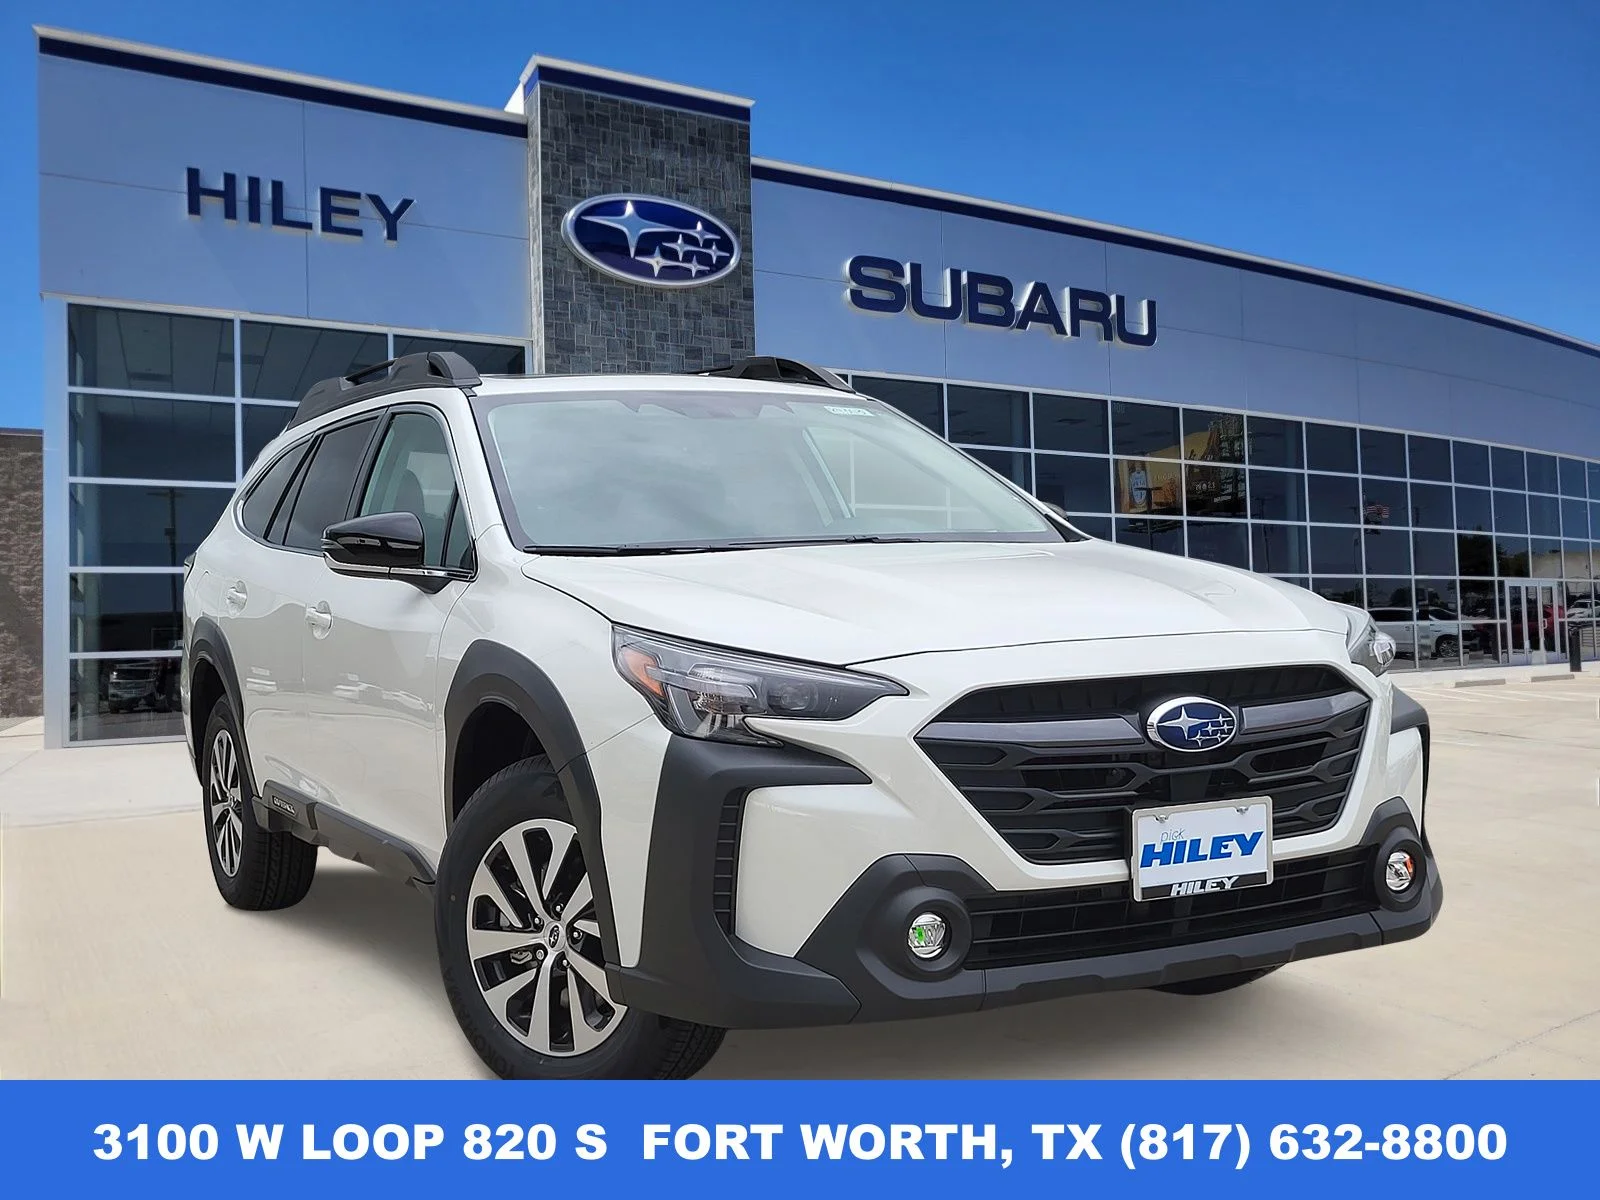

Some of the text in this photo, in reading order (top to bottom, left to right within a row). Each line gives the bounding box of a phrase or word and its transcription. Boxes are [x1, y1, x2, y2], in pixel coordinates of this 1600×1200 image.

[187, 166, 415, 242] HILEY
[847, 254, 1158, 347] SUBARU
[1139, 830, 1265, 869] HILEY
[1160, 827, 1187, 843] pick
[1170, 875, 1240, 897] HILEY
